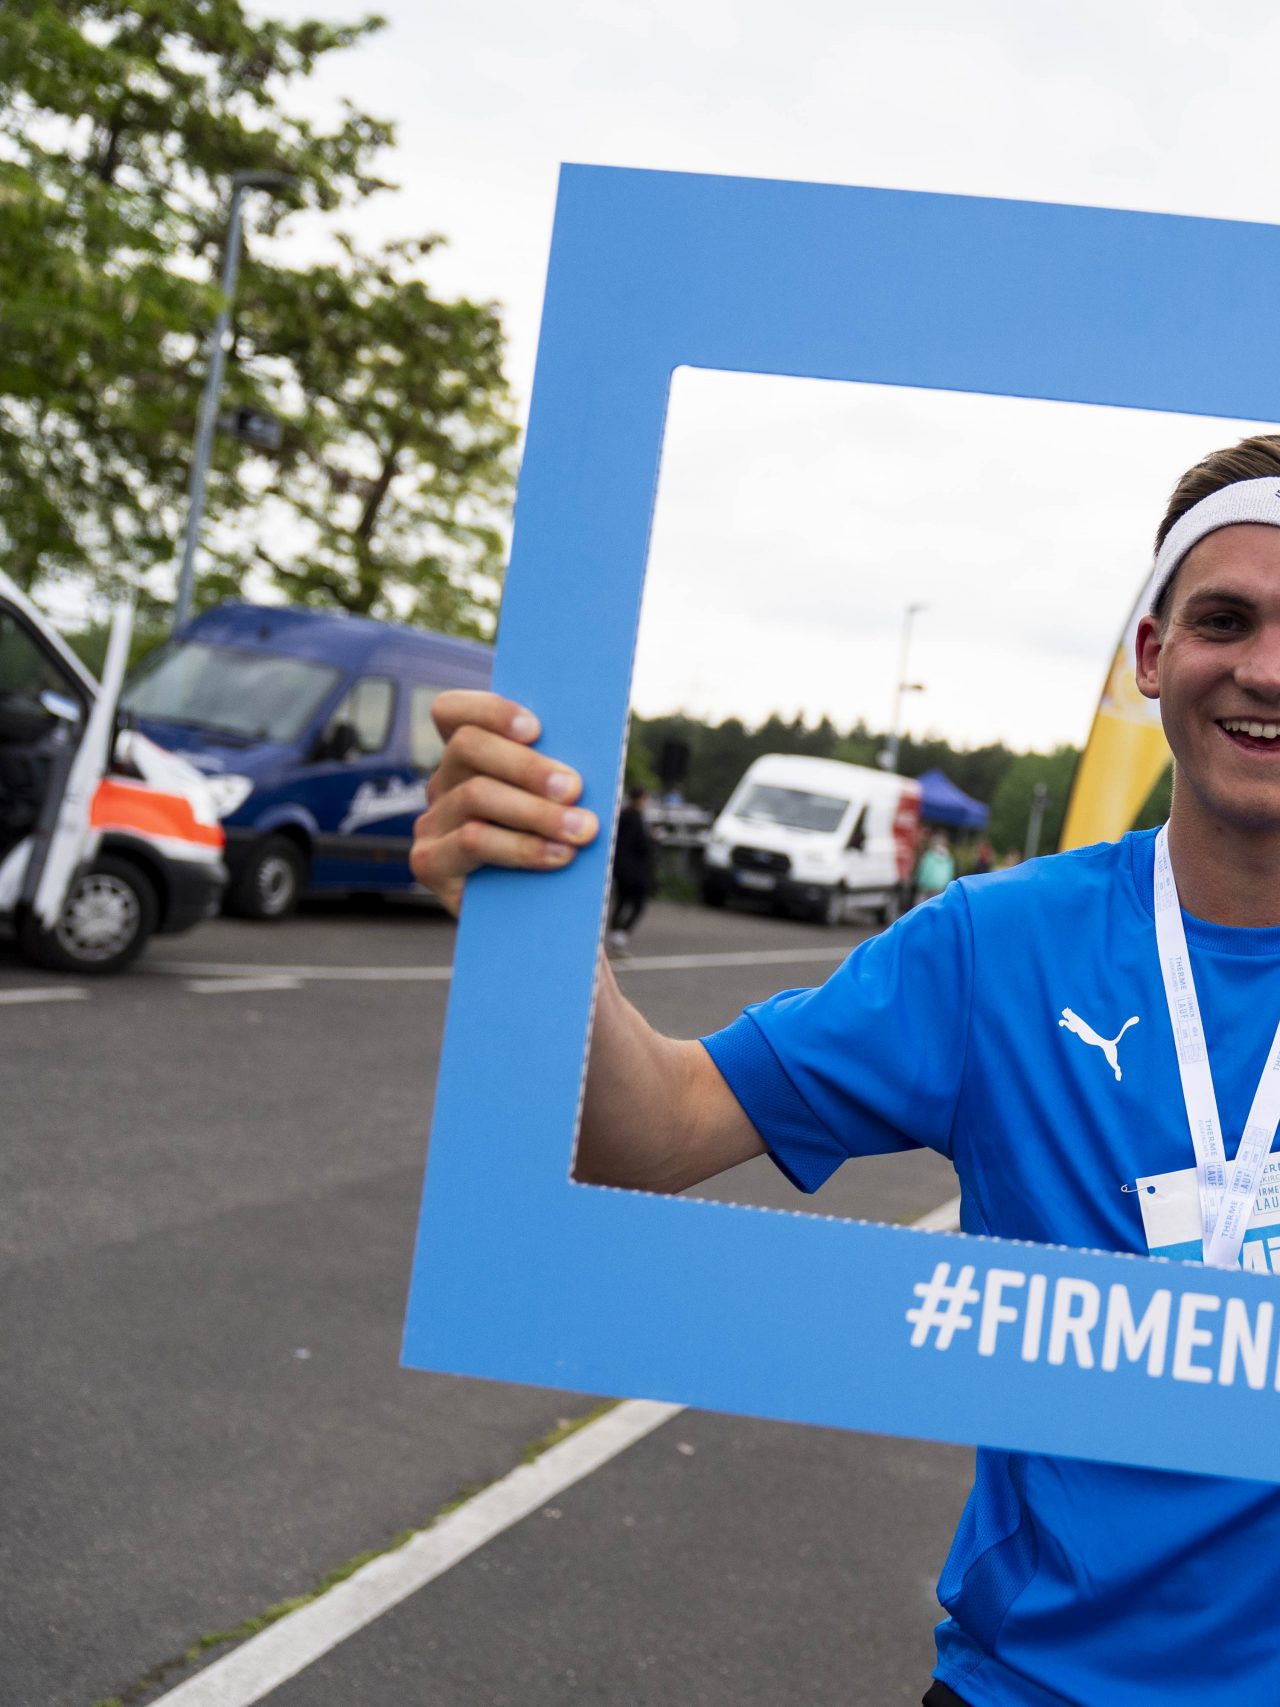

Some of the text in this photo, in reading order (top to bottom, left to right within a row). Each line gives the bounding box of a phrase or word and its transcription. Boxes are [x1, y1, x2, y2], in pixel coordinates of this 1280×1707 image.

[1175, 956, 1188, 991] THERME
[1177, 998, 1189, 1019] LAUF
[1205, 1119, 1218, 1157] THERME
[1206, 1164, 1217, 1187] LAUF
[1240, 1171, 1253, 1194] LAUF
[1221, 1199, 1239, 1237] THERME
